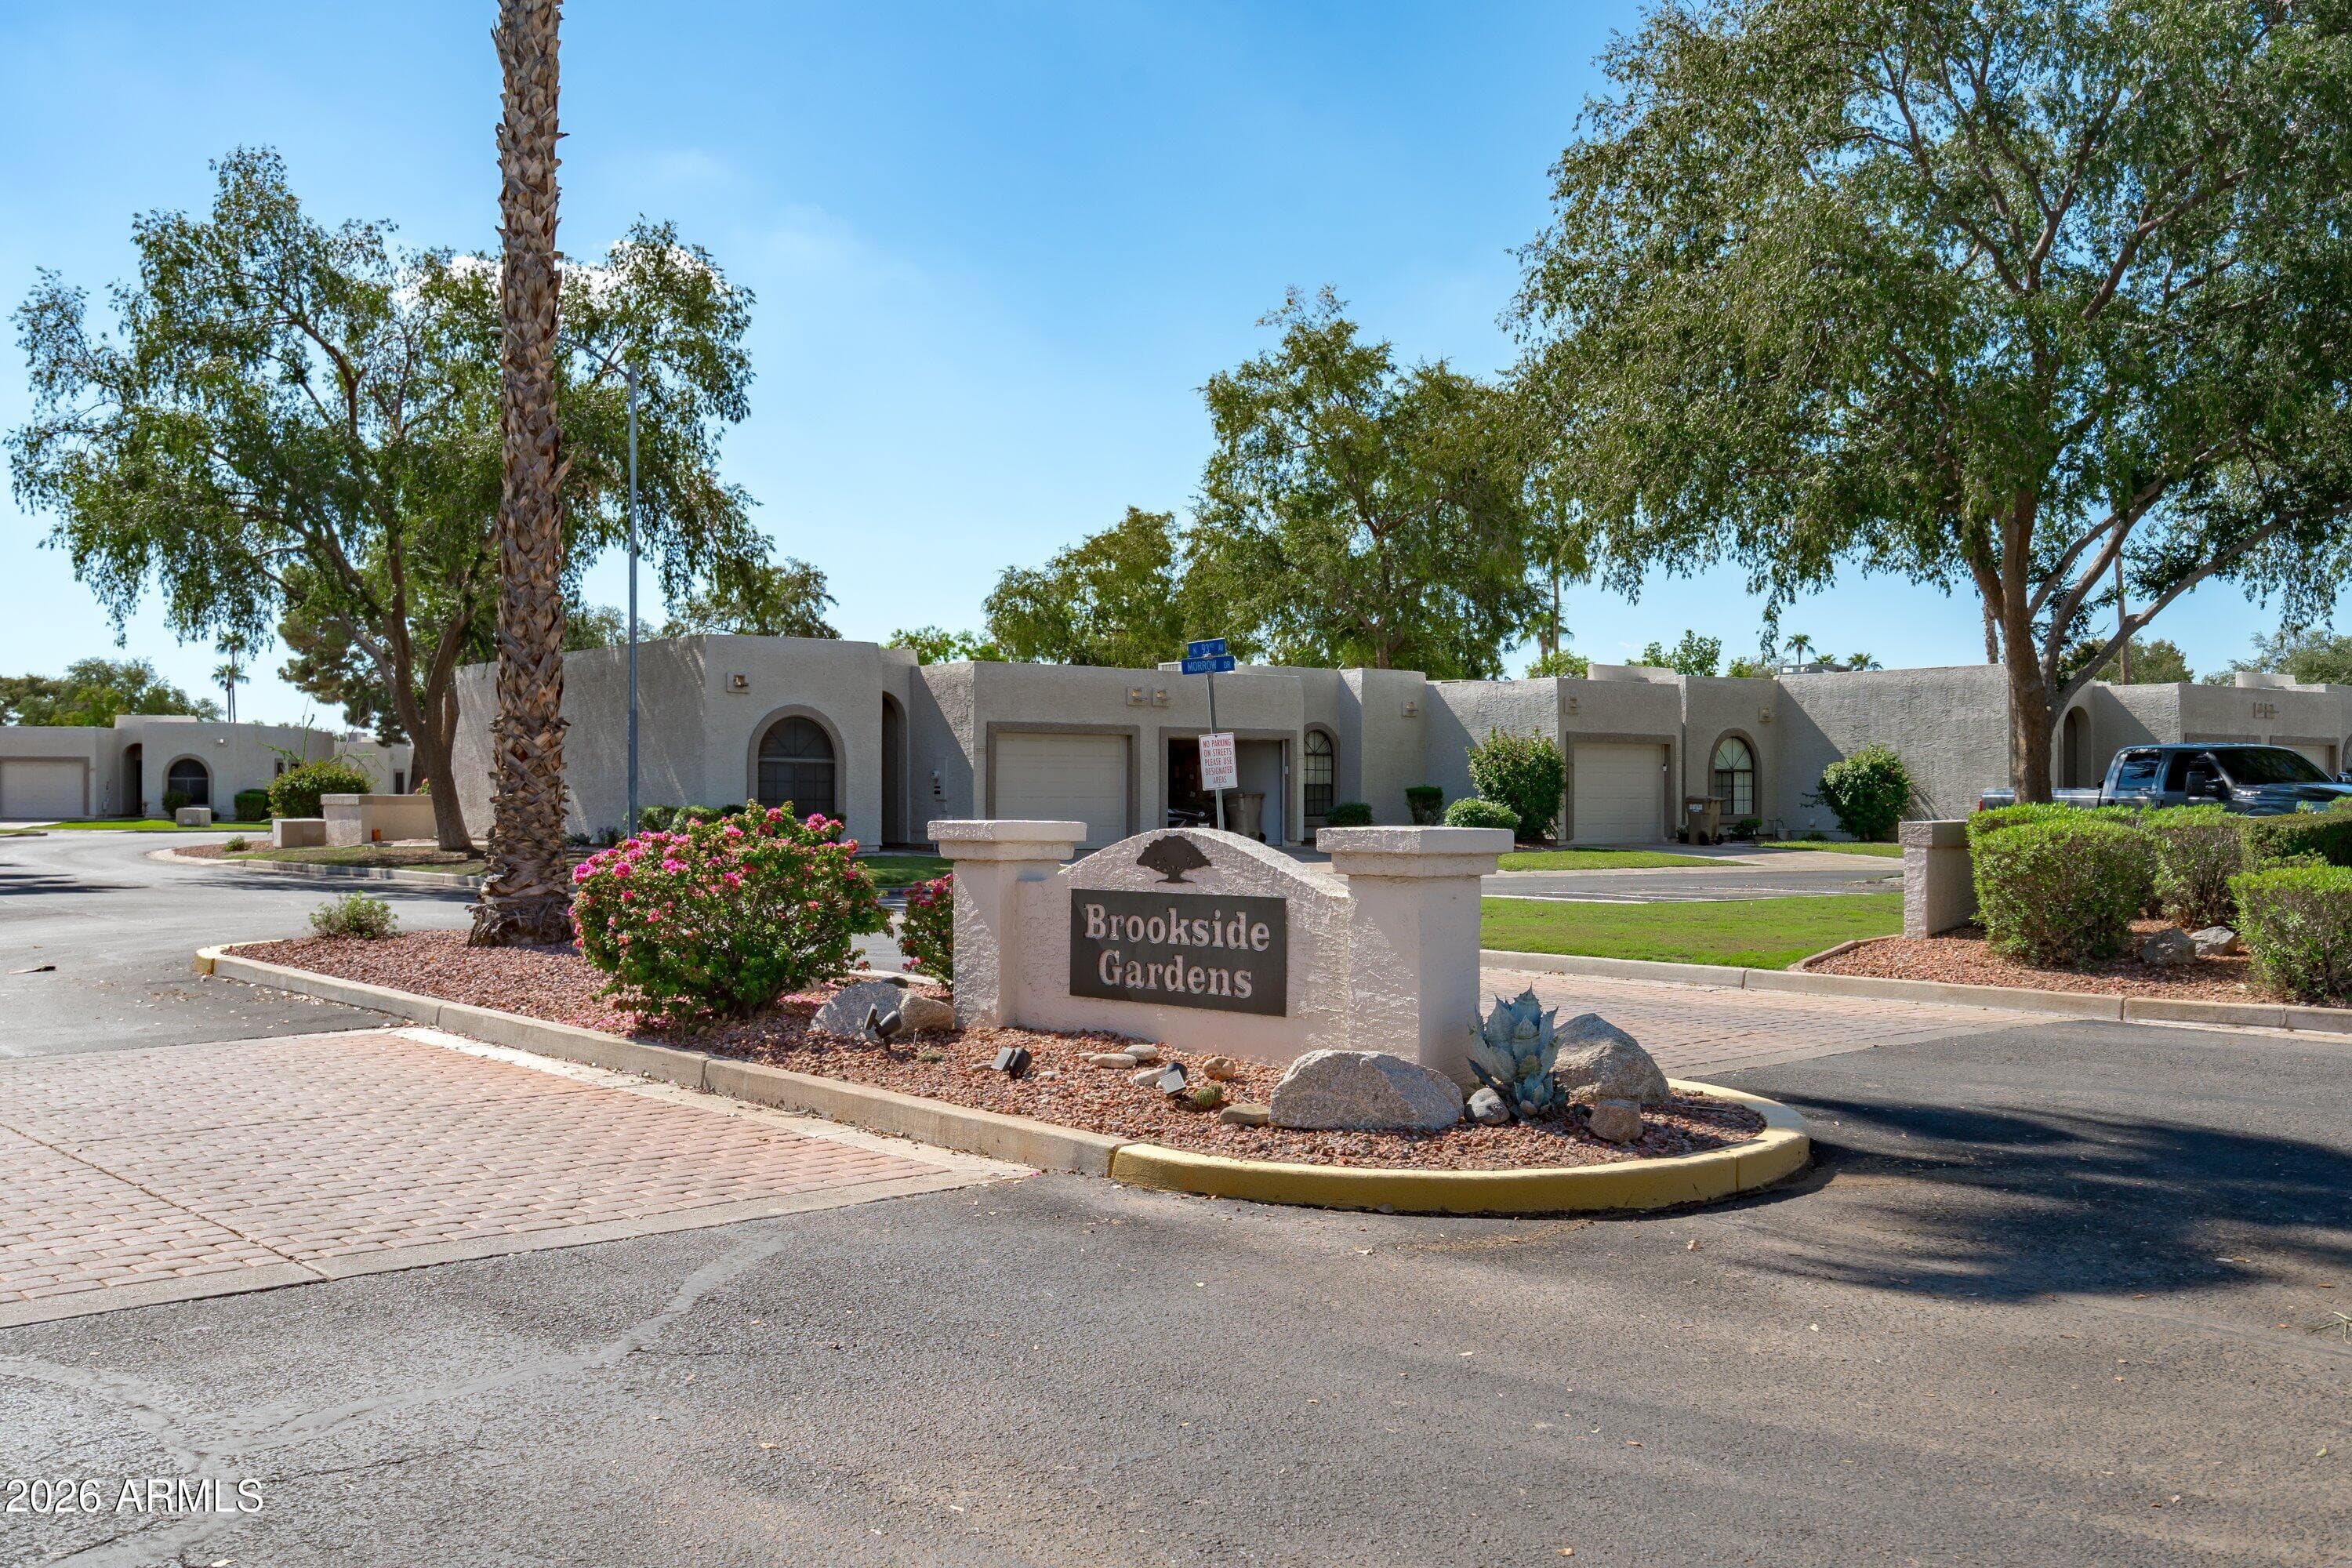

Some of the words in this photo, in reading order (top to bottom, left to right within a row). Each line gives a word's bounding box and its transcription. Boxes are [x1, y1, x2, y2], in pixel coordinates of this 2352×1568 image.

[1192, 646, 1197, 655] N
[1187, 660, 1217, 672] MORROW
[1212, 739, 1231, 747] PARKING
[1212, 748, 1232, 757] STREETS
[1205, 766, 1232, 775] DESIGNATED
[1084, 903, 1270, 952] Brookside
[1098, 949, 1253, 999] Gardens
